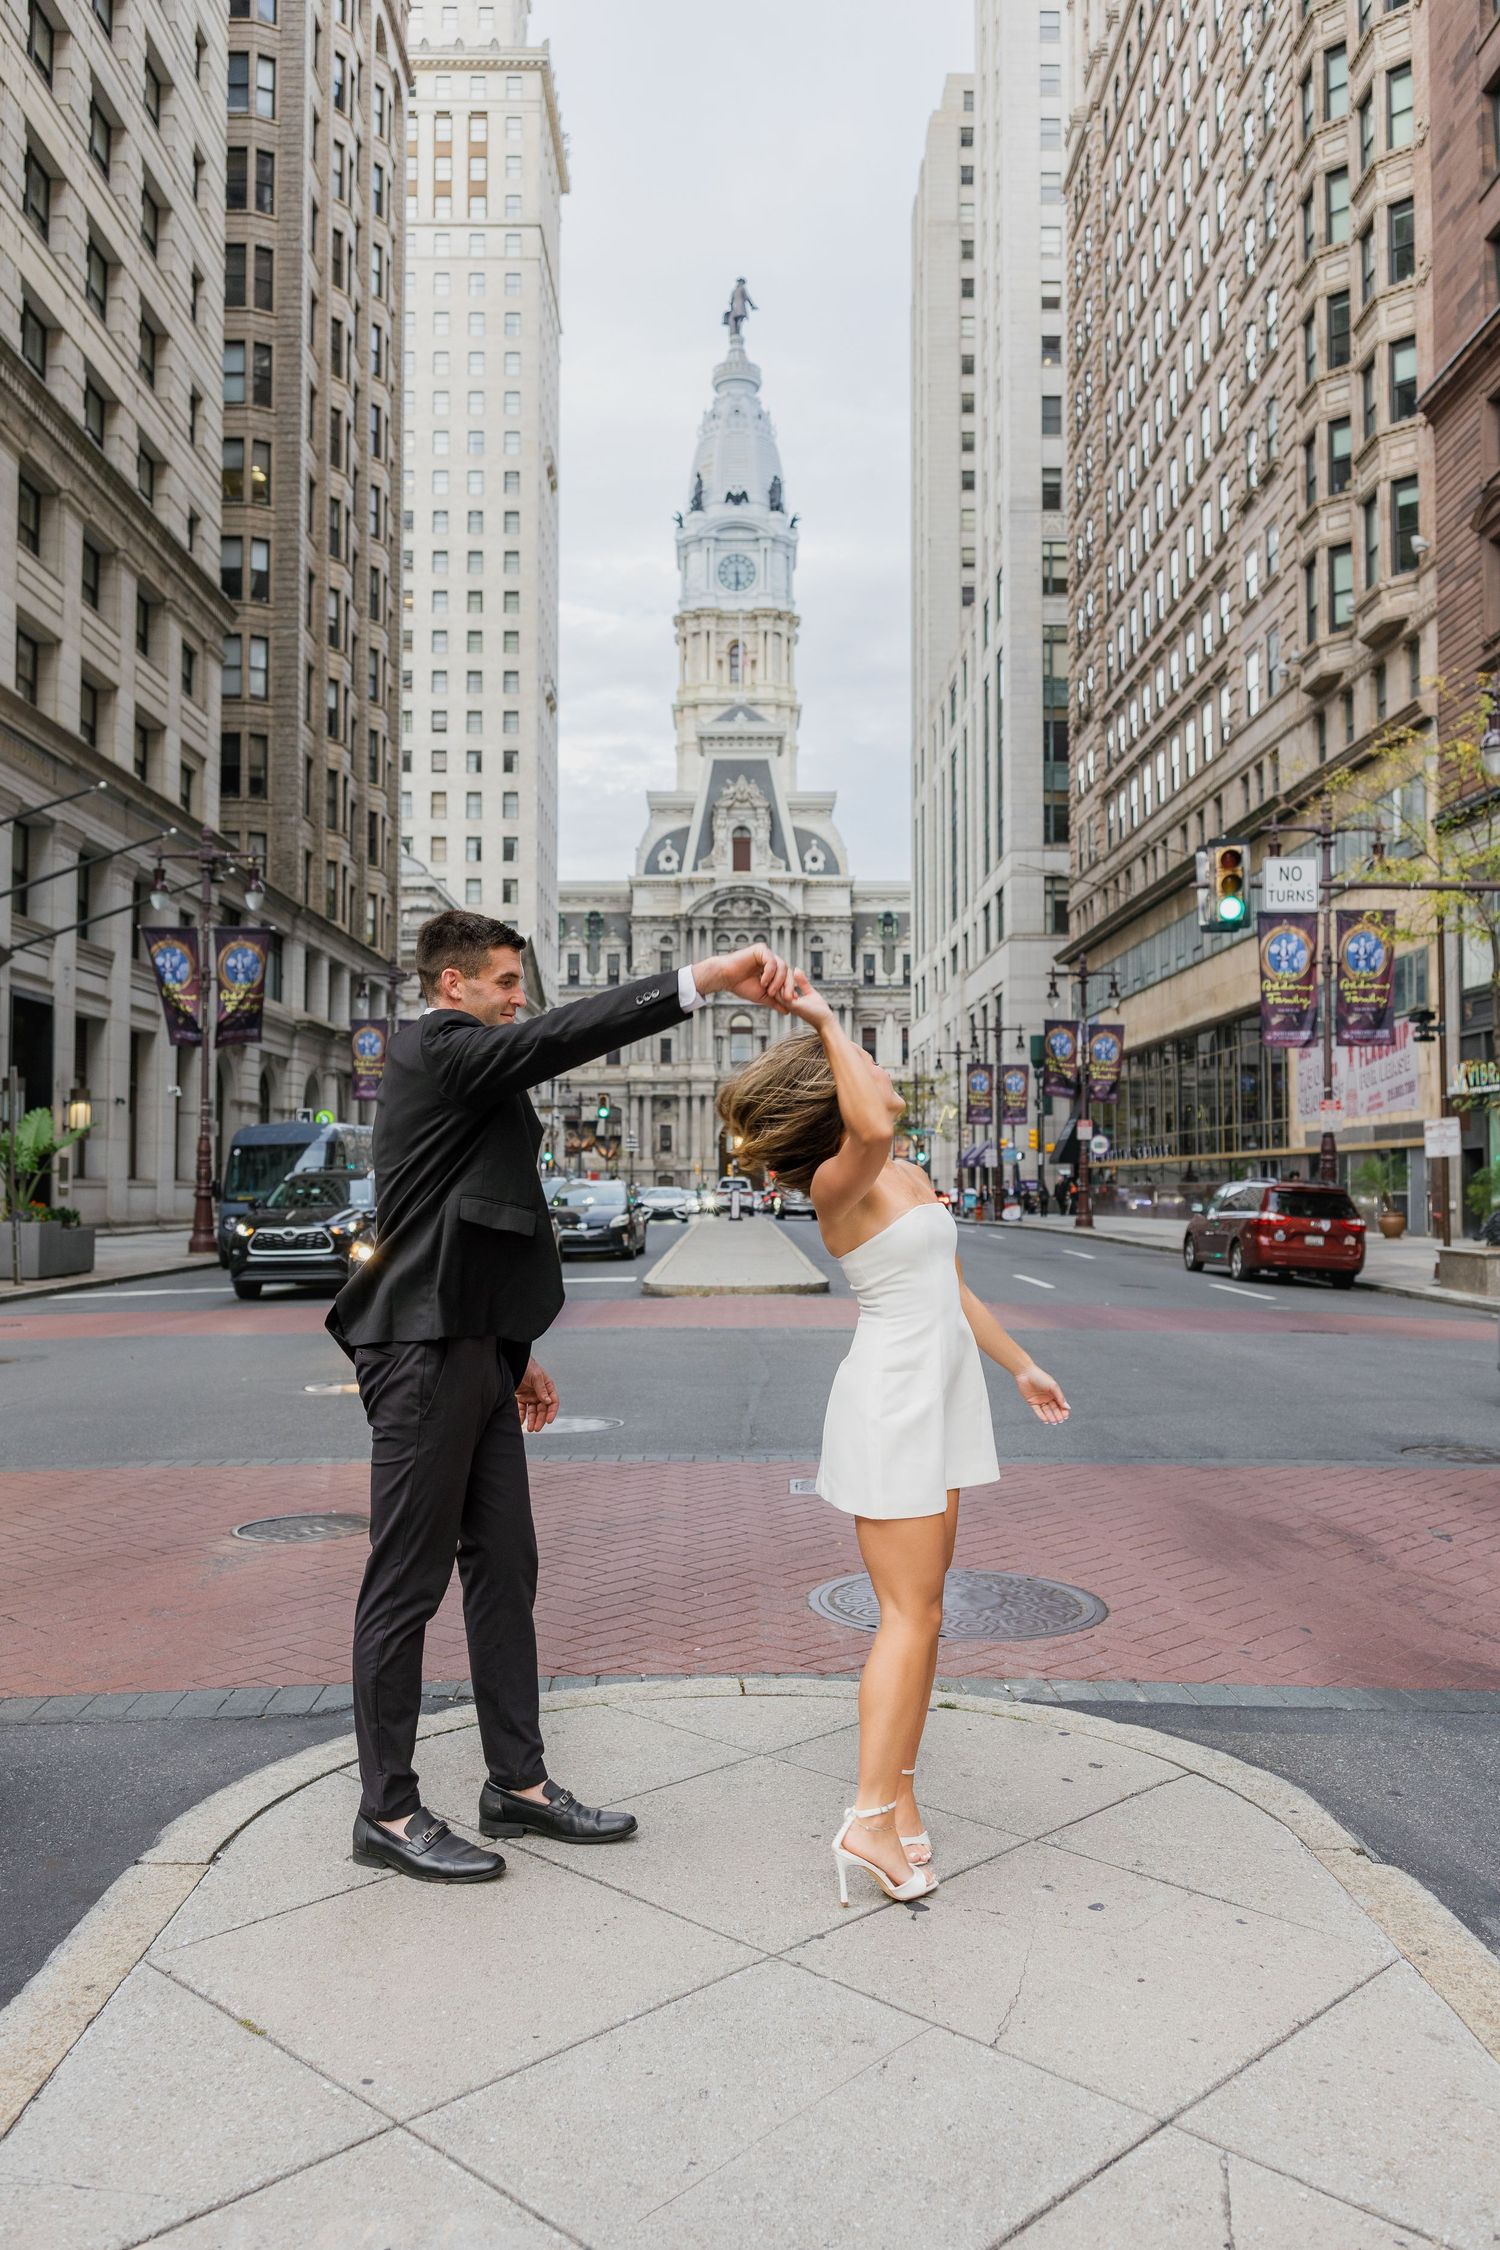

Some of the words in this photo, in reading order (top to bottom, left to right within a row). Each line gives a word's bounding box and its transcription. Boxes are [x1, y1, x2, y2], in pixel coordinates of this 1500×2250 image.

[1279, 865, 1303, 882] NO
[1267, 889, 1315, 903] TURNS
[1261, 979, 1314, 991] Addams
[1339, 978, 1391, 990] Addams
[1265, 992, 1312, 1010] Family
[1343, 991, 1388, 1008] Family
